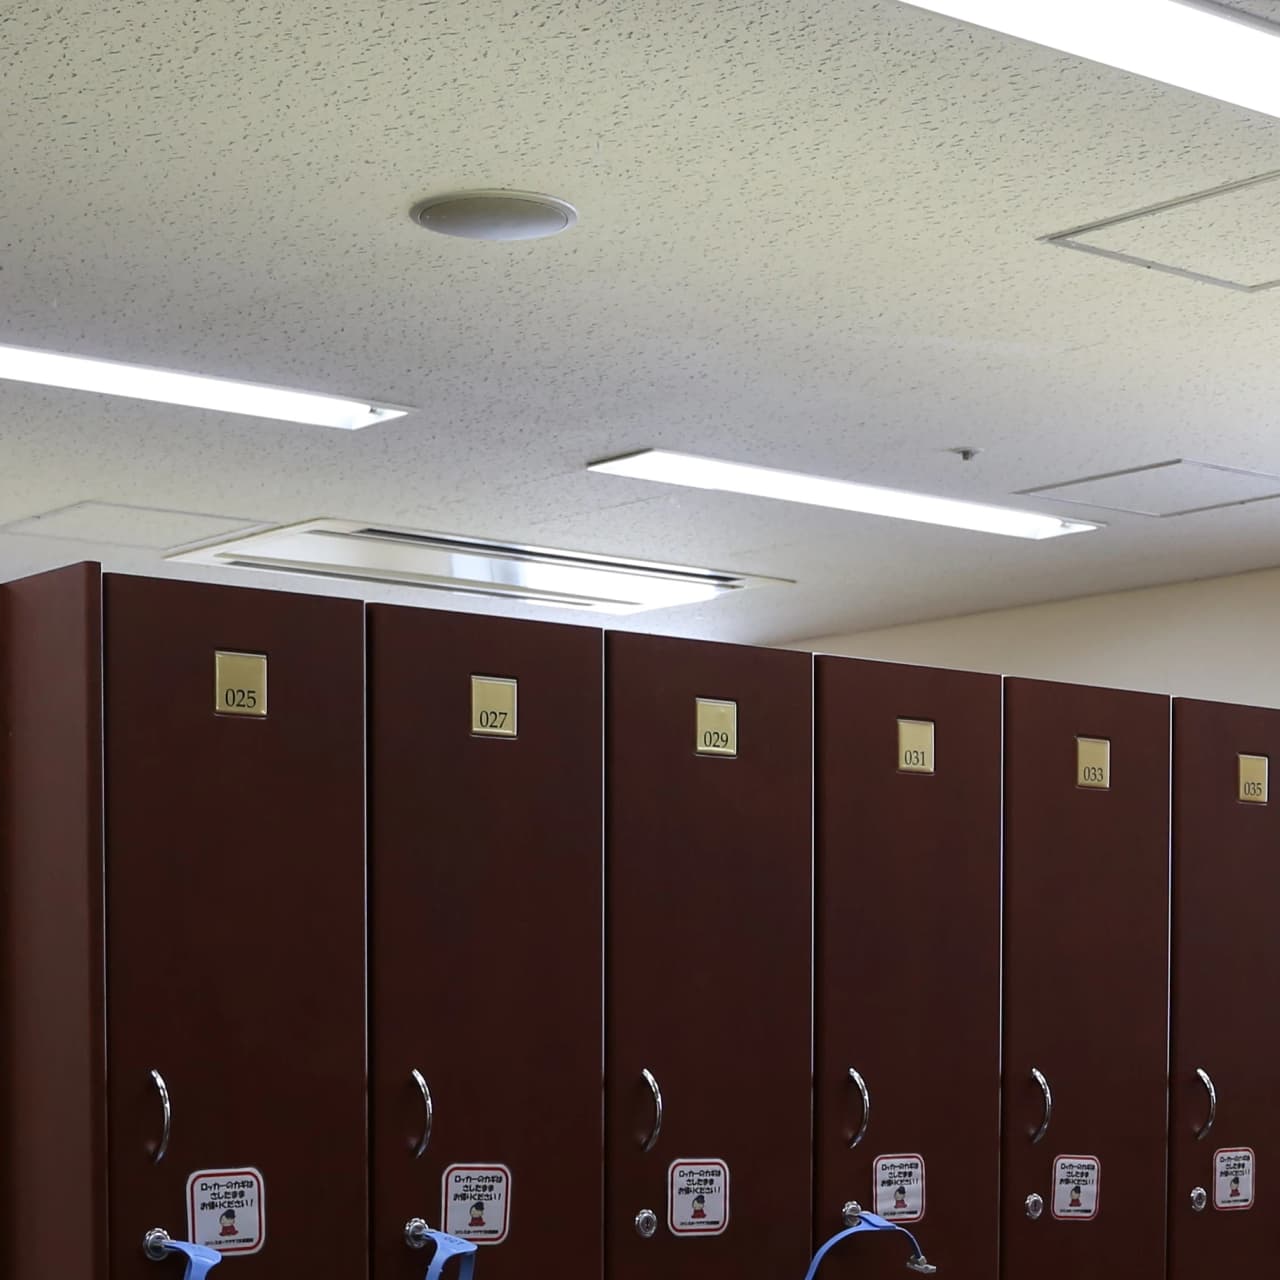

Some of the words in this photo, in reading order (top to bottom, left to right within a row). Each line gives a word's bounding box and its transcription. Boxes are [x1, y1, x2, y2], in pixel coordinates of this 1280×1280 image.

[225, 689, 257, 708] 025
[479, 711, 508, 729] 027
[704, 731, 729, 749] 029
[905, 750, 926, 767] 031
[1083, 767, 1104, 782] 033
[1244, 781, 1262, 796] 035
[210, 1190, 245, 1200] さしたまま
